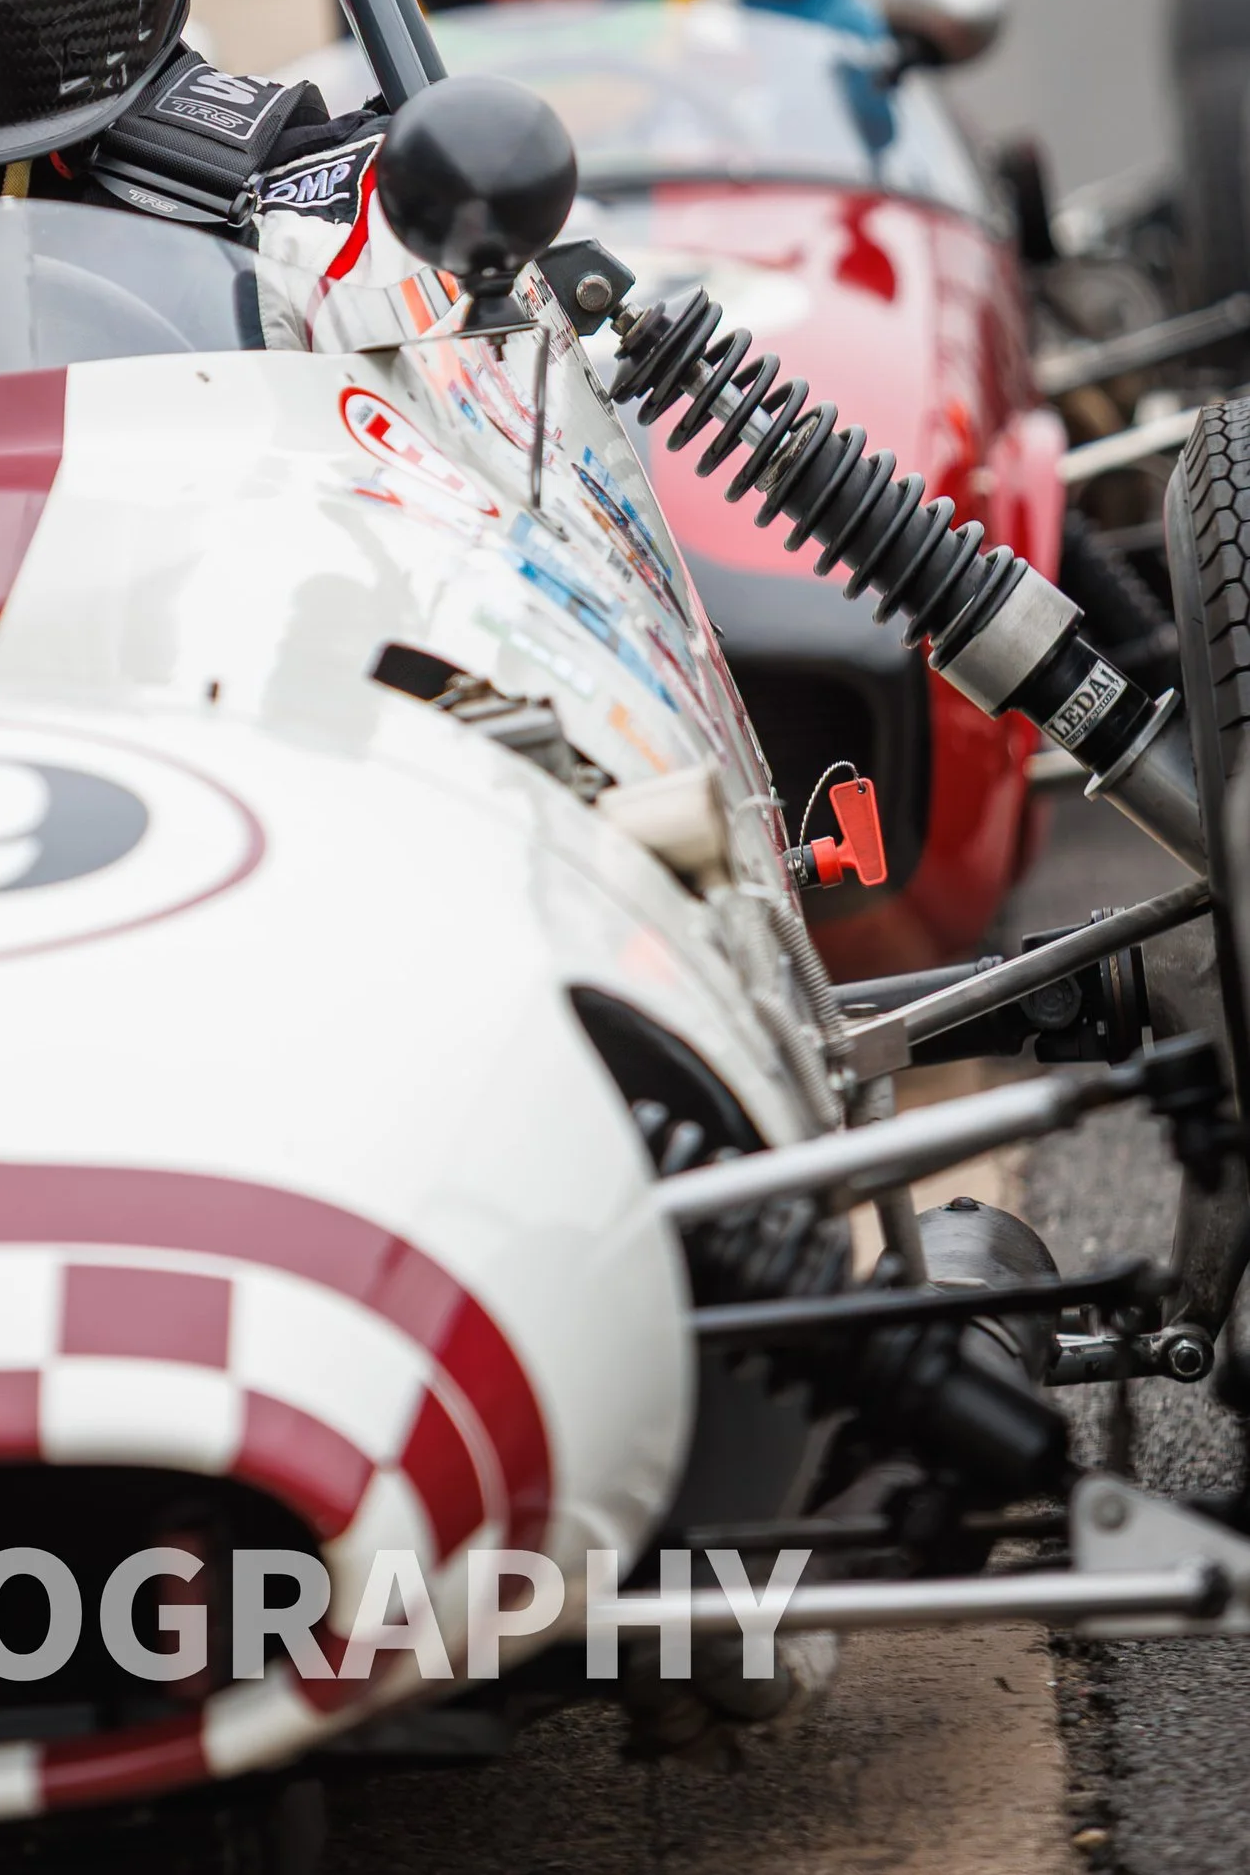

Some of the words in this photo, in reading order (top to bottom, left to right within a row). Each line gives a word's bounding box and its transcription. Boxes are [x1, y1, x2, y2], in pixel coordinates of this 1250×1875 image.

[171, 99, 244, 129] TRS
[128, 188, 179, 213] TRS
[264, 163, 351, 203] OMP
[1049, 678, 1110, 740] LEDA
